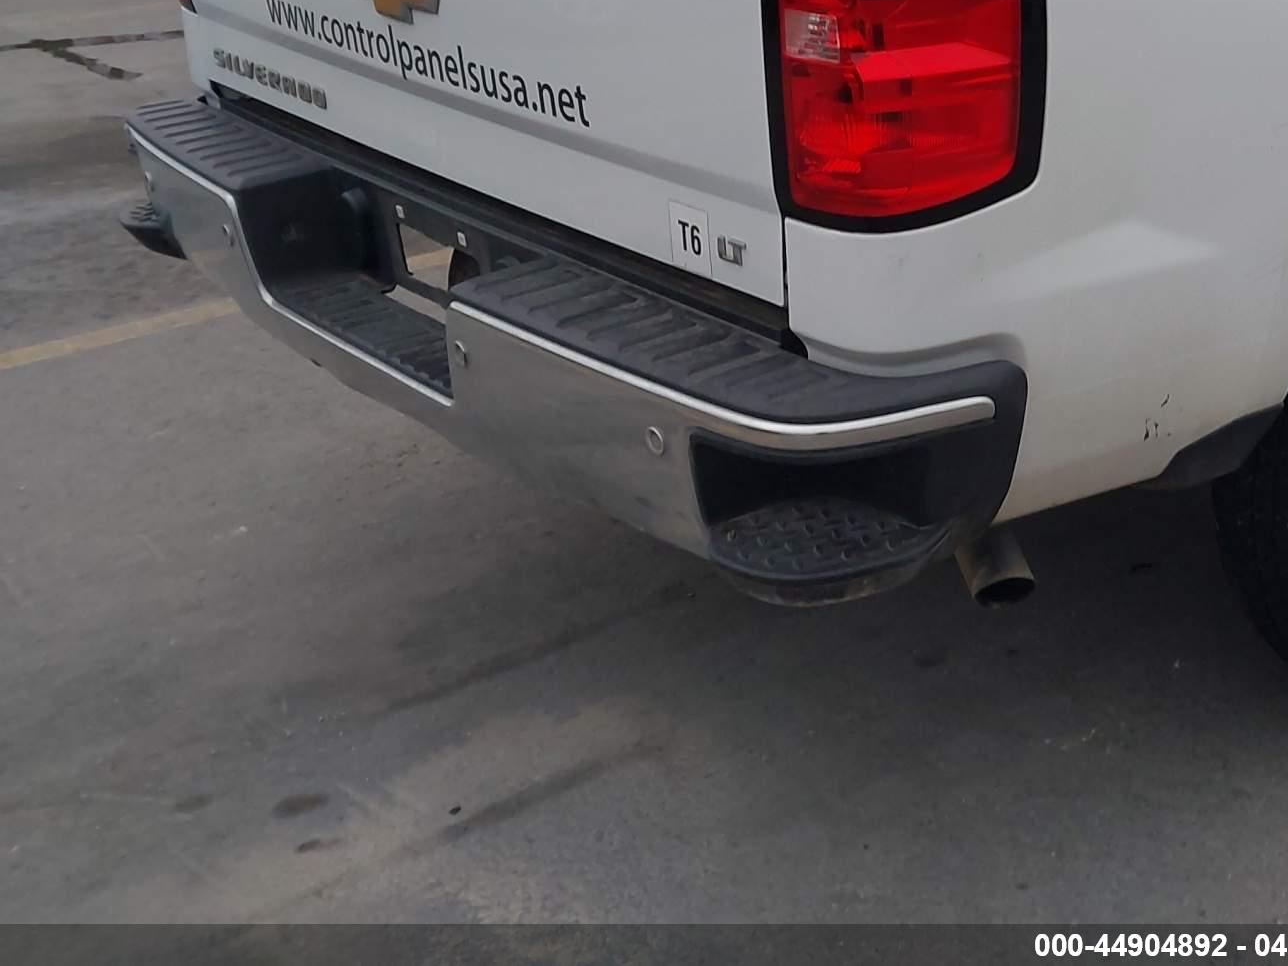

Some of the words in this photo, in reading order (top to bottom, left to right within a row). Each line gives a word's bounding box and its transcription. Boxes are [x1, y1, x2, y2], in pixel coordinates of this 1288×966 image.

[213, 48, 328, 110] SILVERADO
[677, 219, 702, 256] T6
[717, 235, 747, 267] LT
